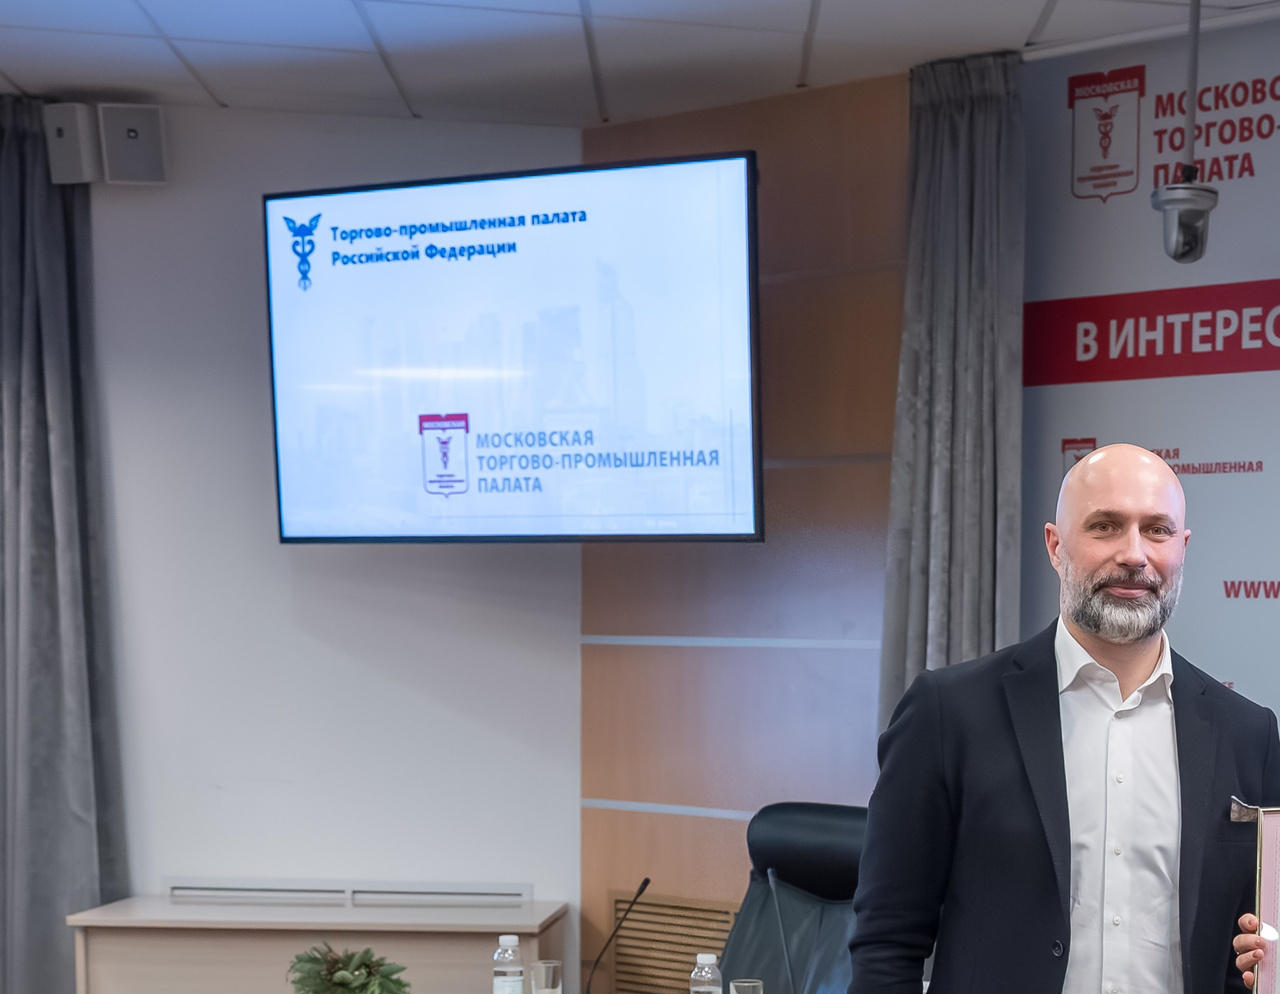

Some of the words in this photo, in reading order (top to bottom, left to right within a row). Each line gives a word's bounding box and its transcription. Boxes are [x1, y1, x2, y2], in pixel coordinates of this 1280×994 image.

[1153, 152, 1255, 188] ПАЛАТА
[331, 215, 526, 244] Торгово-промышленная
[531, 210, 587, 226] палата
[332, 245, 420, 266] Российской
[425, 241, 517, 261] Федерации
[1076, 321, 1099, 361] В
[476, 430, 594, 448] МОСКОВСКАЯ
[477, 450, 720, 471] ТОРГОВО-ПРОМЫШЛЕННАЯ
[1170, 461, 1263, 475] ОМЫШЛЕННАЯ
[478, 477, 543, 493] ПАЛАТА
